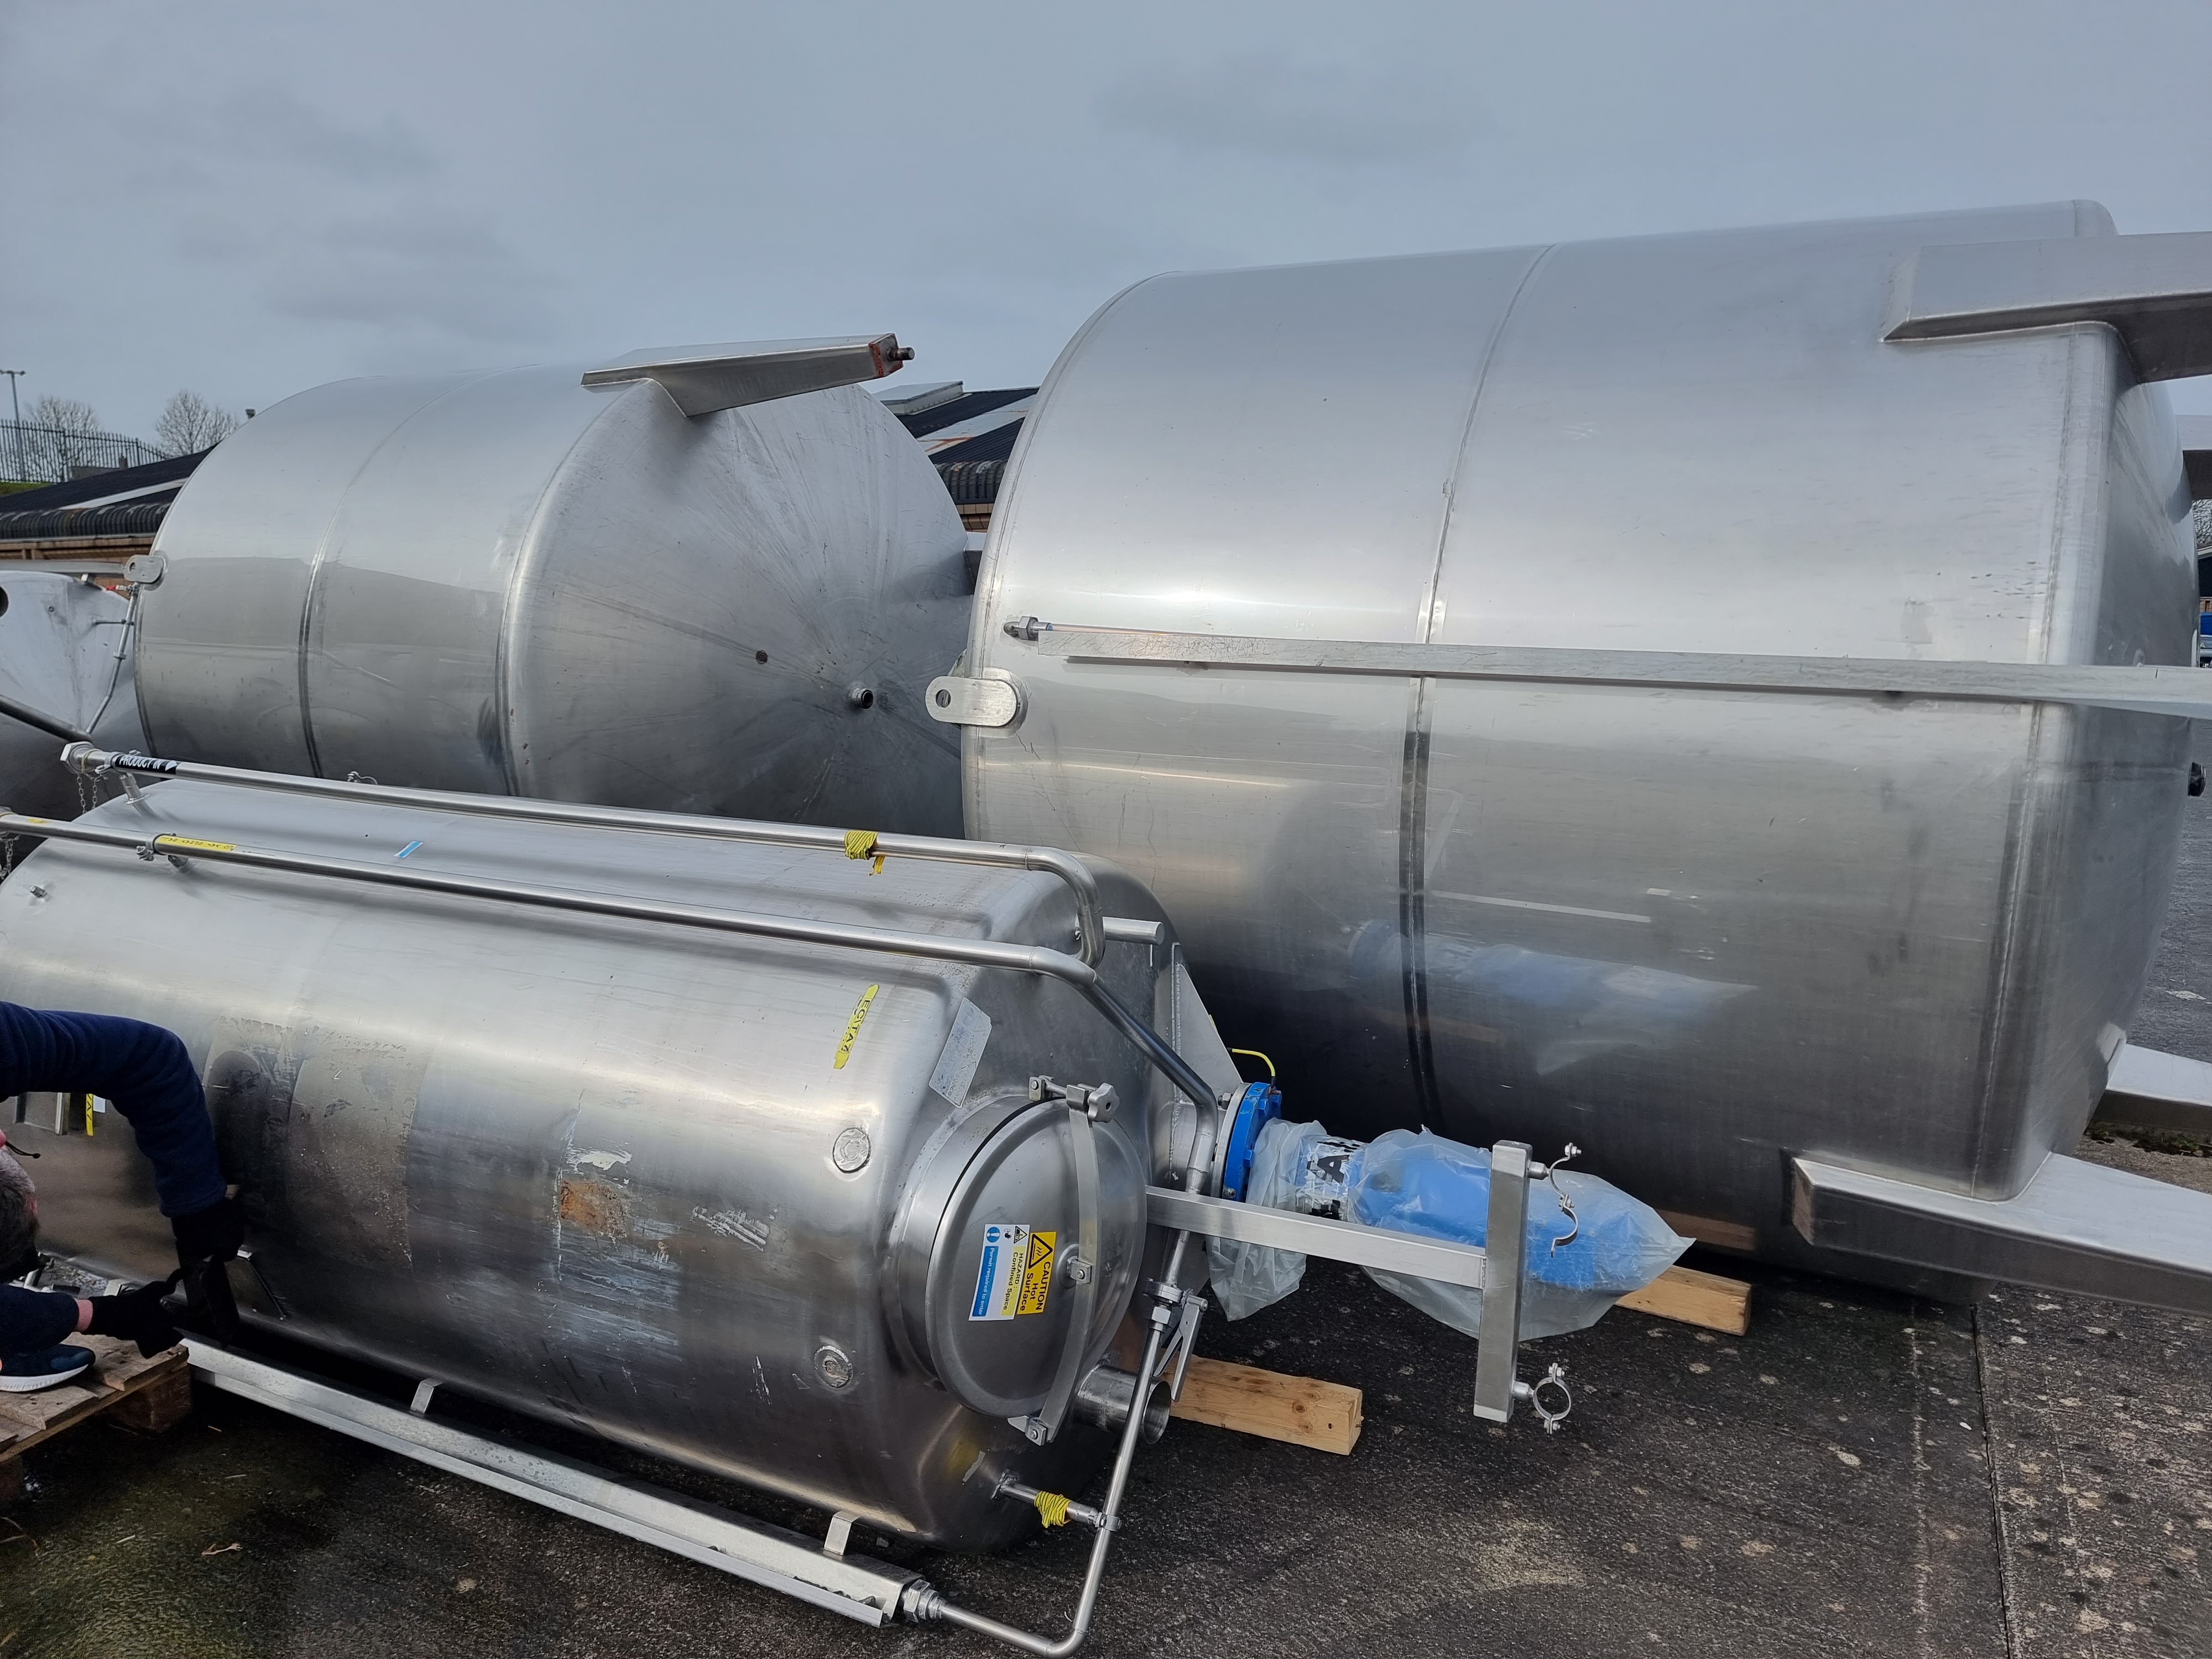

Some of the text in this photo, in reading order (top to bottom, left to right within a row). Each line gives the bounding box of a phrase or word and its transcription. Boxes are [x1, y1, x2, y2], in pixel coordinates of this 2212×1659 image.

[119, 755, 165, 769] PRODUCT IN
[1003, 1252, 1018, 1310] Confined Space
[1020, 1272, 1034, 1311] Surface
[1030, 1283, 1039, 1300] Hot
[1036, 1261, 1051, 1310] CAUTION
